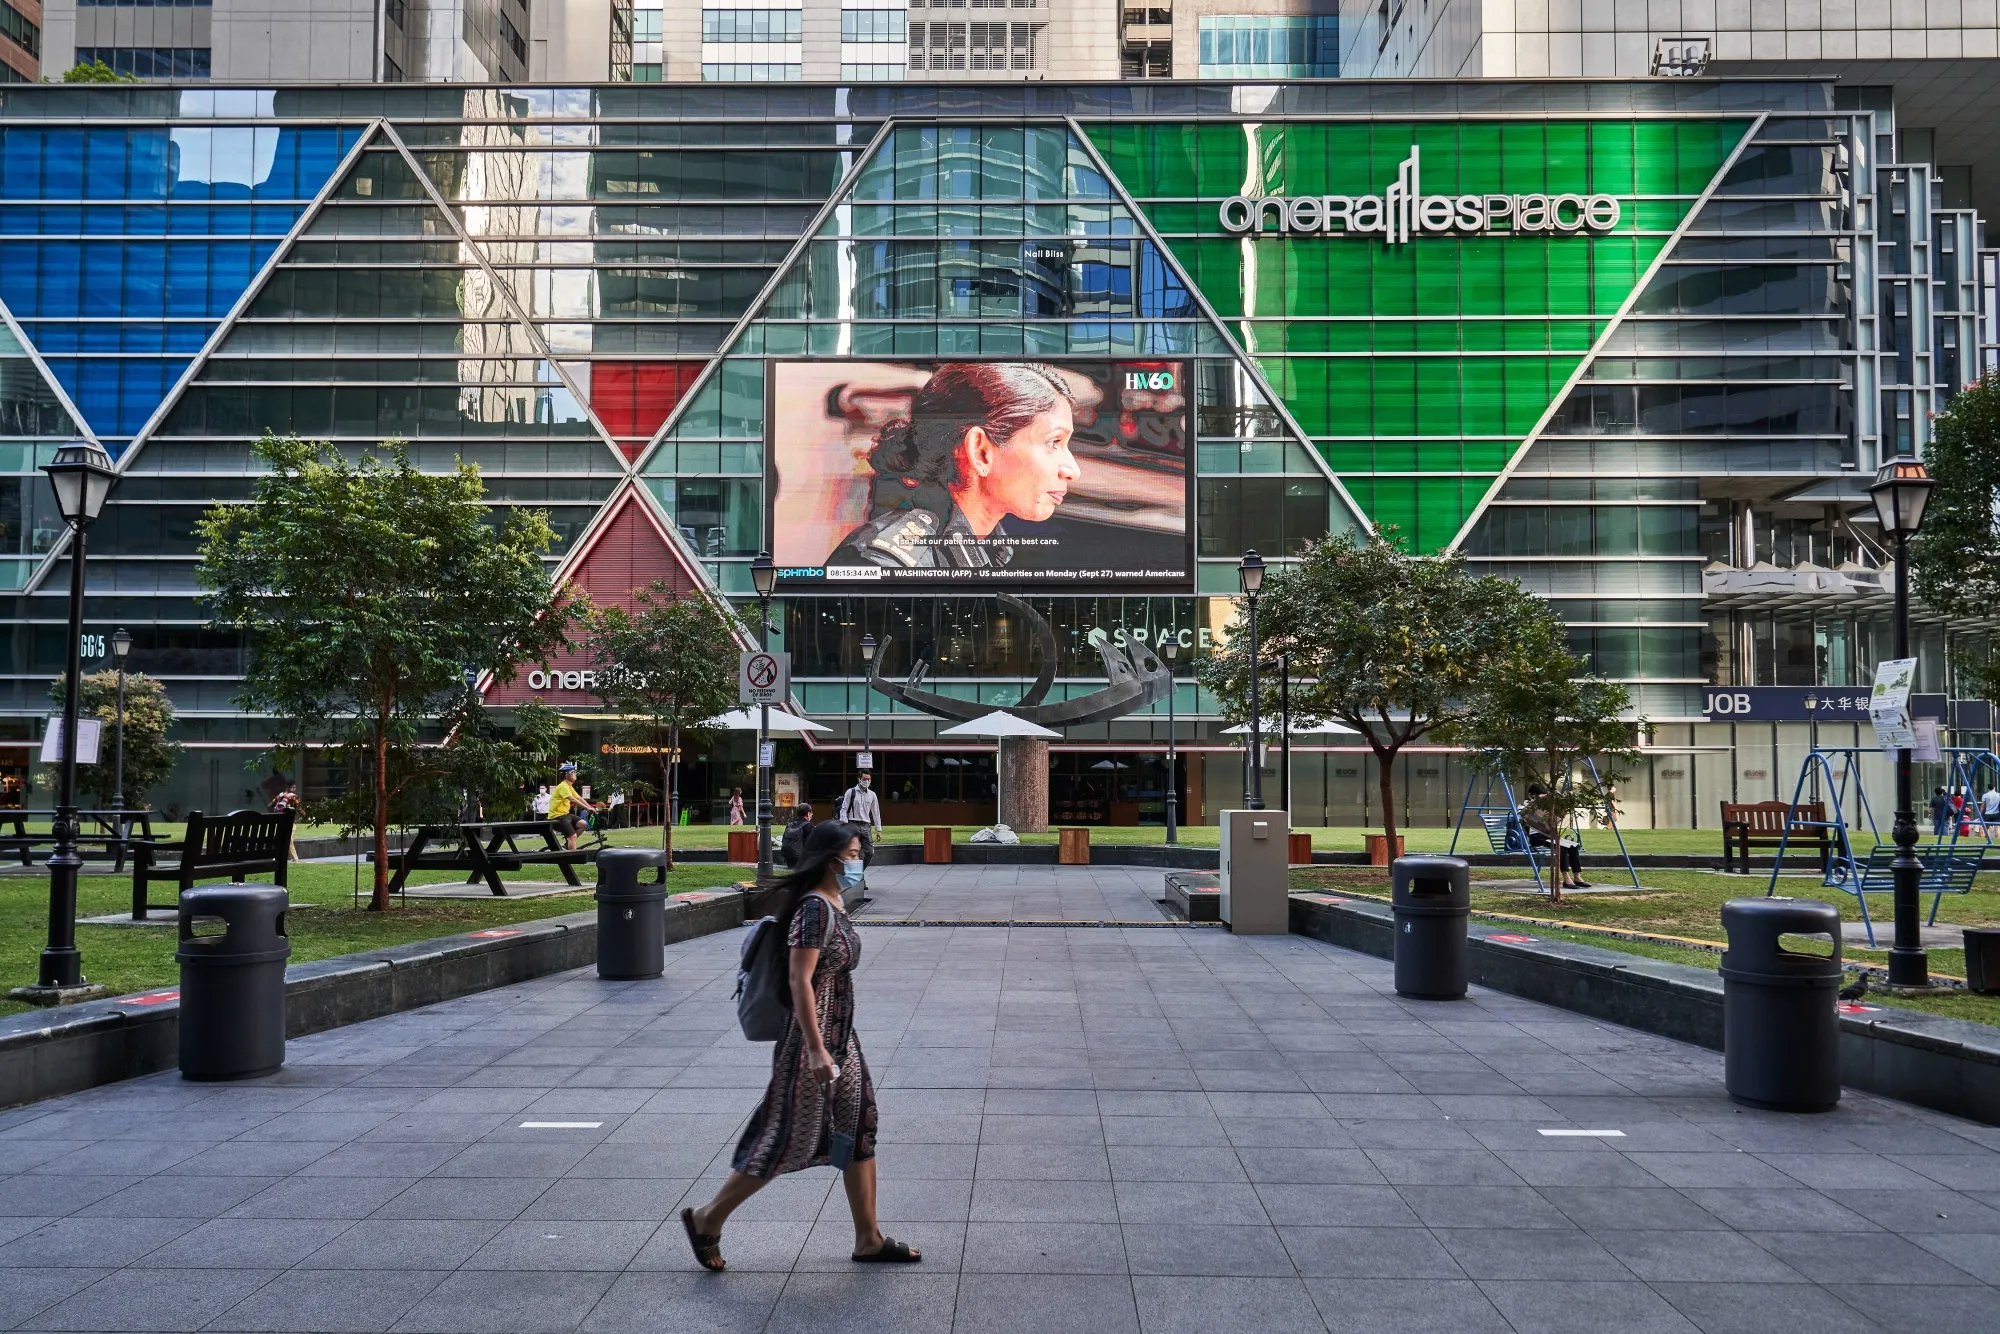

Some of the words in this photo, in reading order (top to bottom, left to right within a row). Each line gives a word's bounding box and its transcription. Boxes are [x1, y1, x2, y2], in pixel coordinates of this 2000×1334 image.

[1024, 250, 1043, 258] Nail
[1045, 250, 1064, 258] Bliss
[943, 538, 976, 547] patients
[992, 538, 1006, 547] get
[830, 569, 862, 577] 08:15:34
[863, 569, 878, 577] AM
[894, 569, 950, 577] WASHINGTON
[951, 569, 973, 578] (AFP)
[979, 569, 990, 577] US
[991, 569, 1033, 577] authorities
[1045, 569, 1078, 579] Monday
[1078, 569, 1100, 578] (Sept
[1100, 569, 1113, 578] 27)
[1114, 569, 1144, 577] warned
[1145, 569, 1186, 577] Americans
